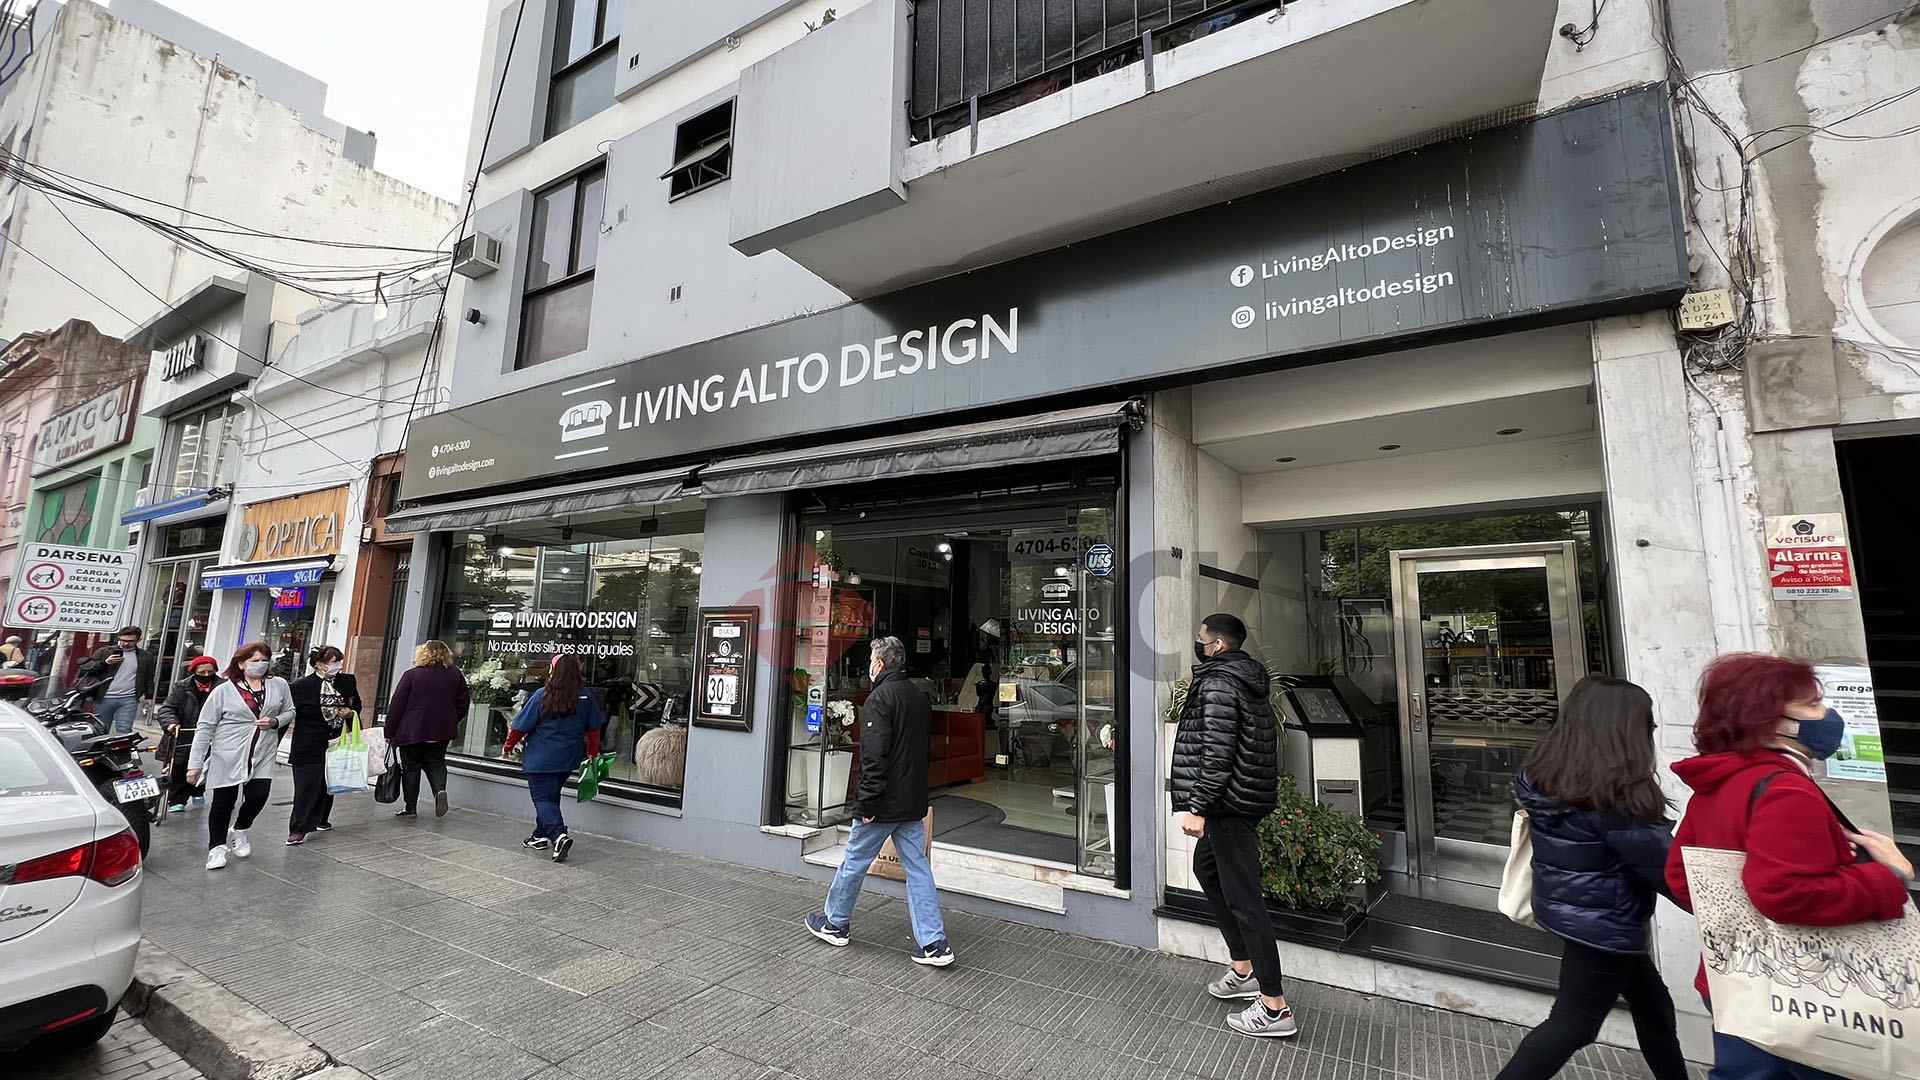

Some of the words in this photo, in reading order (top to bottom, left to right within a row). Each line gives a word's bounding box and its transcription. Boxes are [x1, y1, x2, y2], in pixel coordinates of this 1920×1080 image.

[1262, 225, 1454, 279] LivingAltoDesign
[1265, 271, 1453, 321] livingaltodesign
[618, 374, 725, 430] LIVING
[730, 352, 829, 408] ALTO
[840, 307, 1018, 387] DESIGN
[38, 395, 118, 451] AMIGO
[264, 511, 340, 557] OPTICA
[1776, 535, 1835, 544] verisure
[37, 548, 122, 564] DARSENA
[1088, 552, 1113, 568] USS
[1775, 550, 1842, 562] Alarma
[76, 568, 109, 577] CARGA
[69, 575, 121, 585] DESCARGA
[65, 584, 87, 592] MAX
[91, 585, 102, 593] 15
[61, 600, 107, 609] ASCENSO
[60, 608, 113, 616] DESCENSO
[1018, 608, 1062, 621] LIVING
[515, 611, 554, 629] LIVING
[555, 611, 586, 629] ALTO
[588, 611, 637, 630] DESIGN
[1034, 622, 1082, 635] DESIGN
[488, 640, 500, 652] No
[501, 640, 527, 653] todos
[528, 640, 542, 653] los
[542, 640, 575, 655] sillones
[577, 644, 595, 655] son
[597, 641, 634, 659] iguales
[1837, 685, 1873, 693] mega
[1771, 994, 1905, 1039] DAPPIANO
